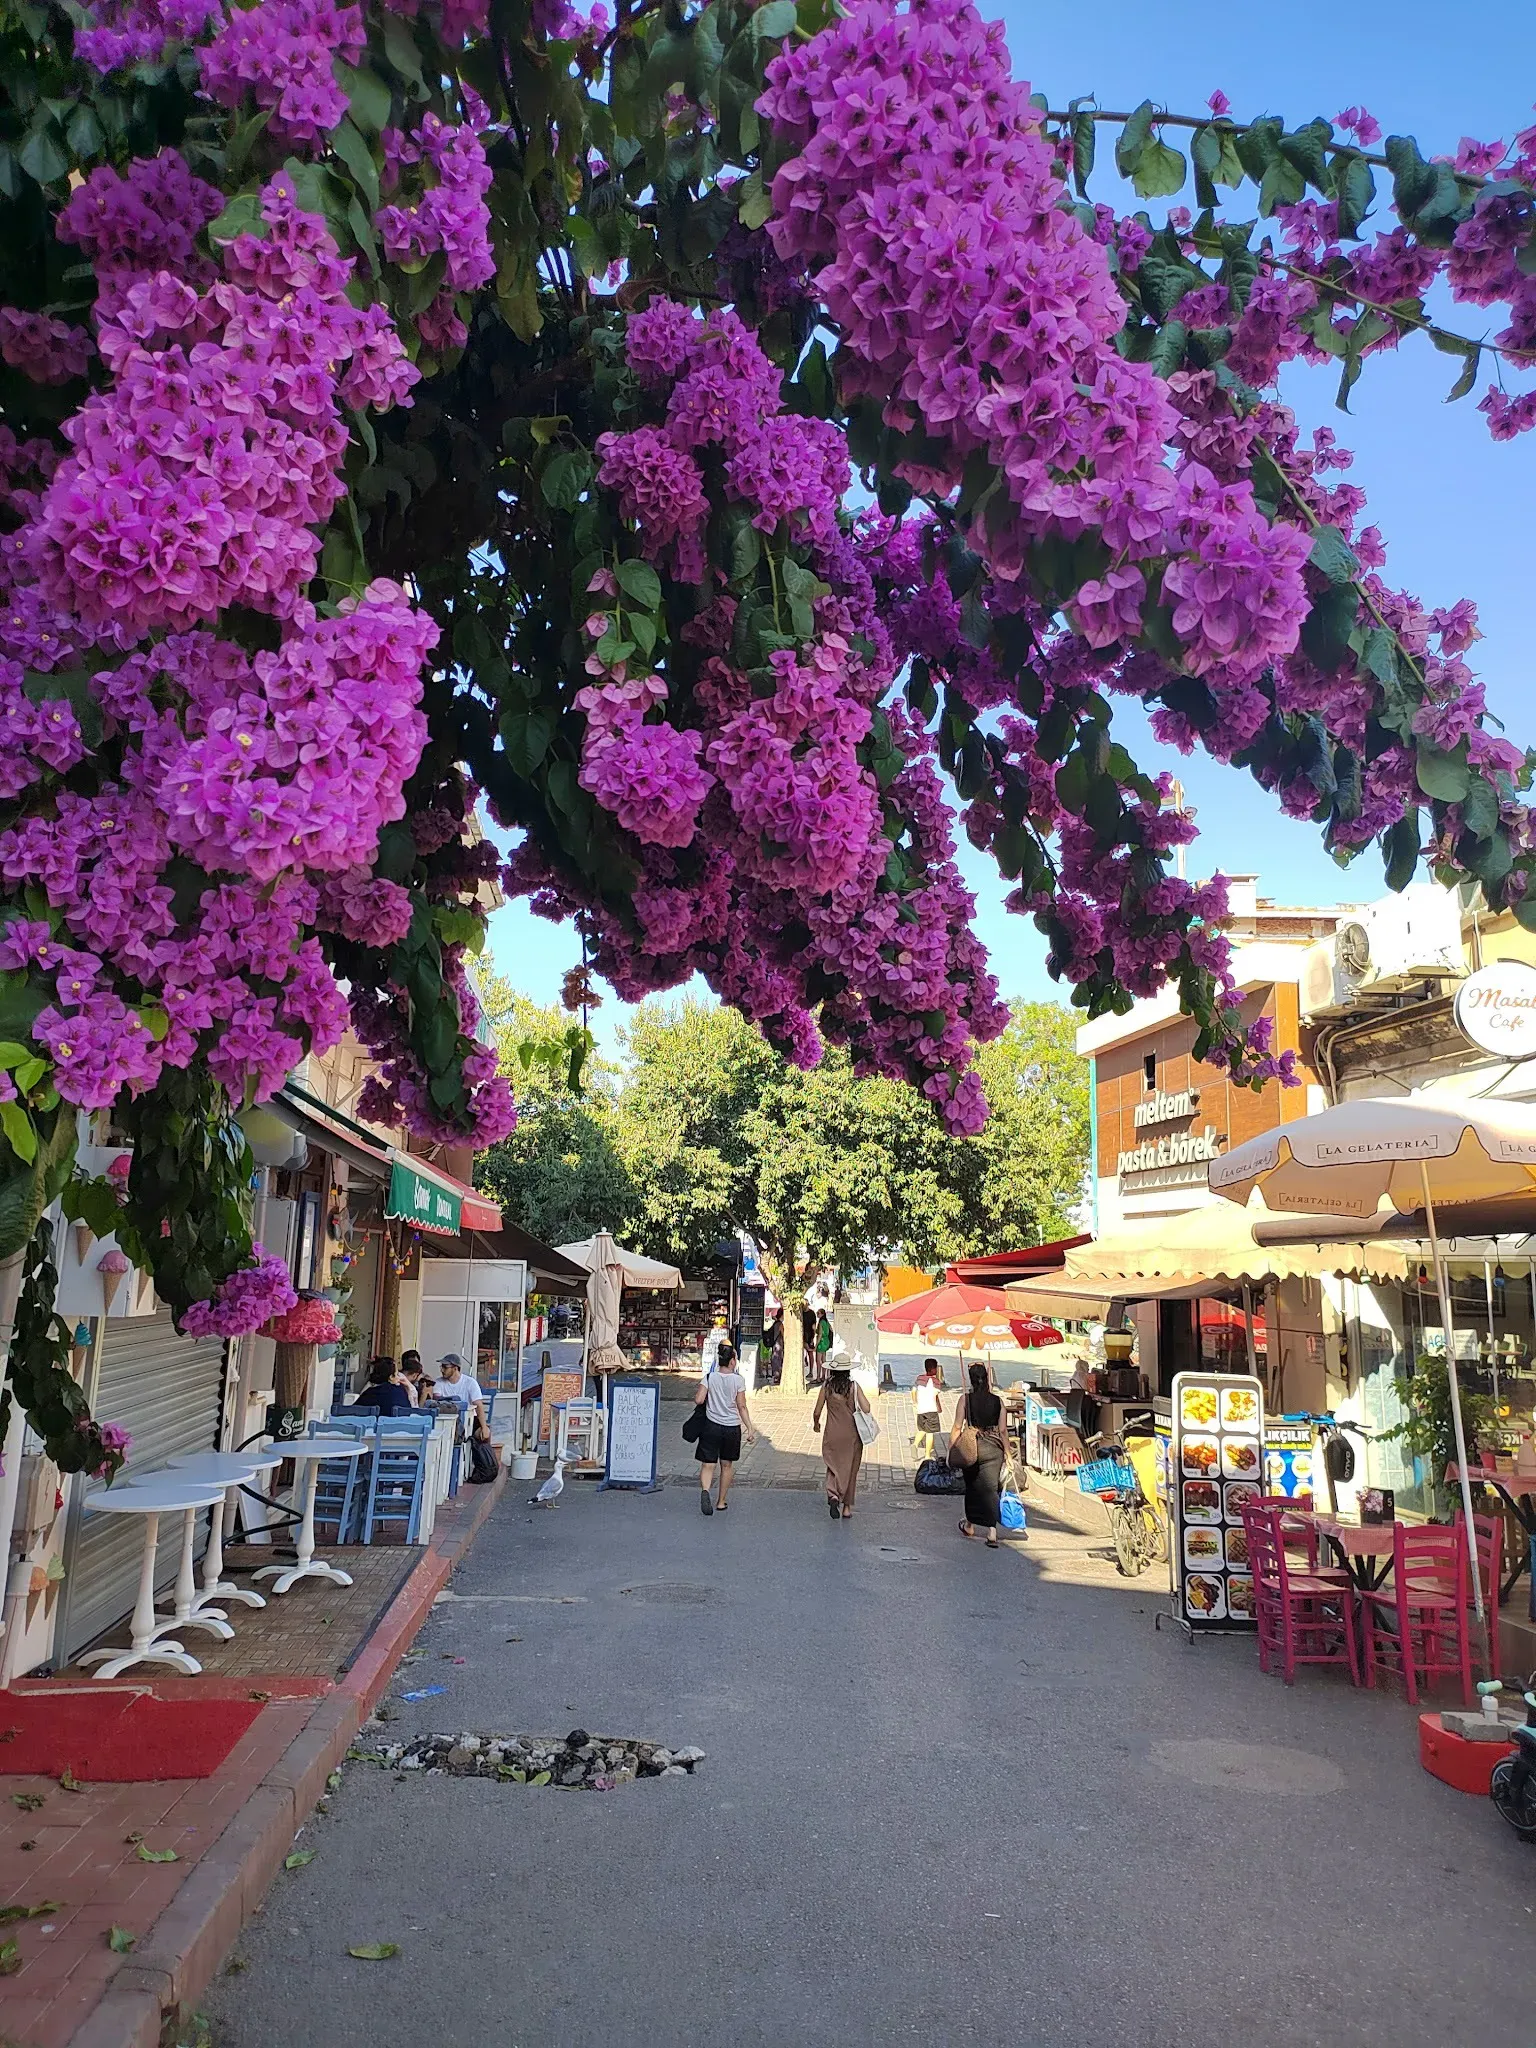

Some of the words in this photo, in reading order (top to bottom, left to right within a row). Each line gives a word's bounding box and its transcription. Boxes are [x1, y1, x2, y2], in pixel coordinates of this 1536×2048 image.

[1489, 1013, 1525, 1032] Cafe
[1134, 1090, 1191, 1128] meltem
[1325, 1146, 1343, 1155] LA
[1347, 1139, 1430, 1154] GELATERIA
[1508, 1144, 1524, 1153] LA
[1117, 1140, 1156, 1177] pasta
[1157, 1140, 1170, 1168] &
[1387, 1497, 1393, 1507] 5
